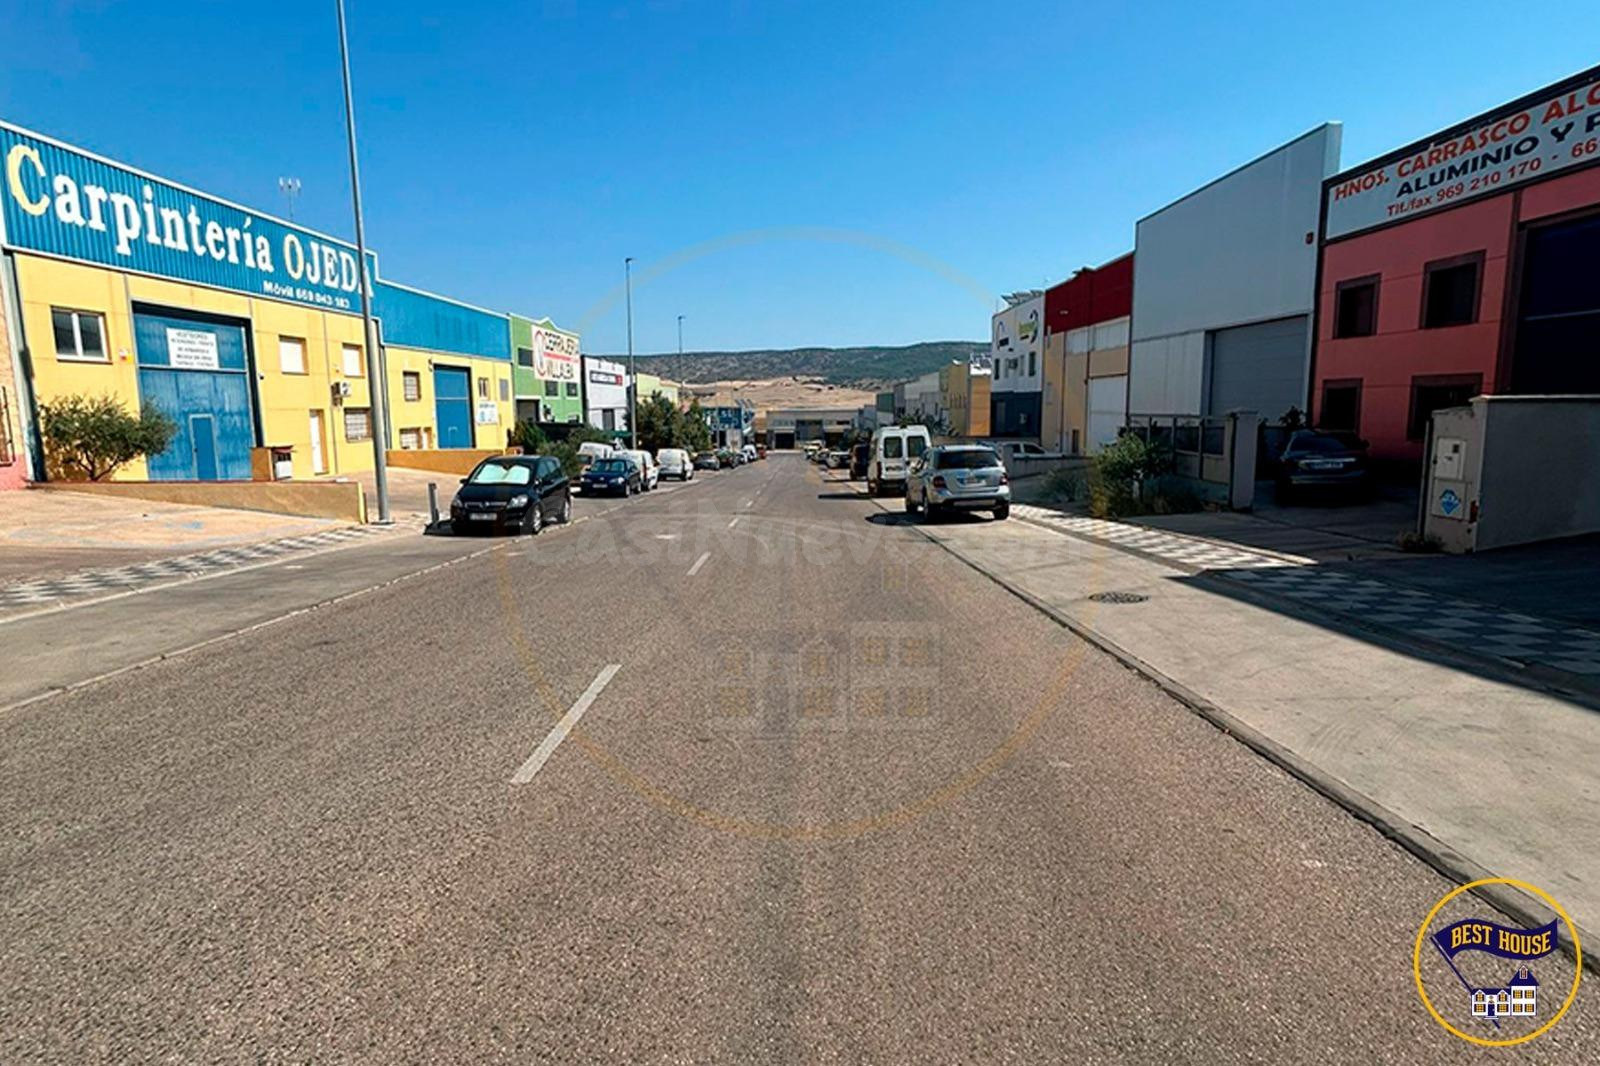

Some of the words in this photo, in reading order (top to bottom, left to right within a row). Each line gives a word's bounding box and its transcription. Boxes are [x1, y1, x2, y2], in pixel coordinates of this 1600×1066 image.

[1334, 169, 1390, 201] HNOS.
[1397, 113, 1532, 178] CARRASCO
[1396, 135, 1540, 198] ALUMINIO
[1550, 121, 1575, 144] Y
[1436, 182, 1465, 202] 969
[1471, 172, 1501, 191] 210
[1508, 156, 1542, 179] 170
[6, 144, 274, 273] Carpintería
